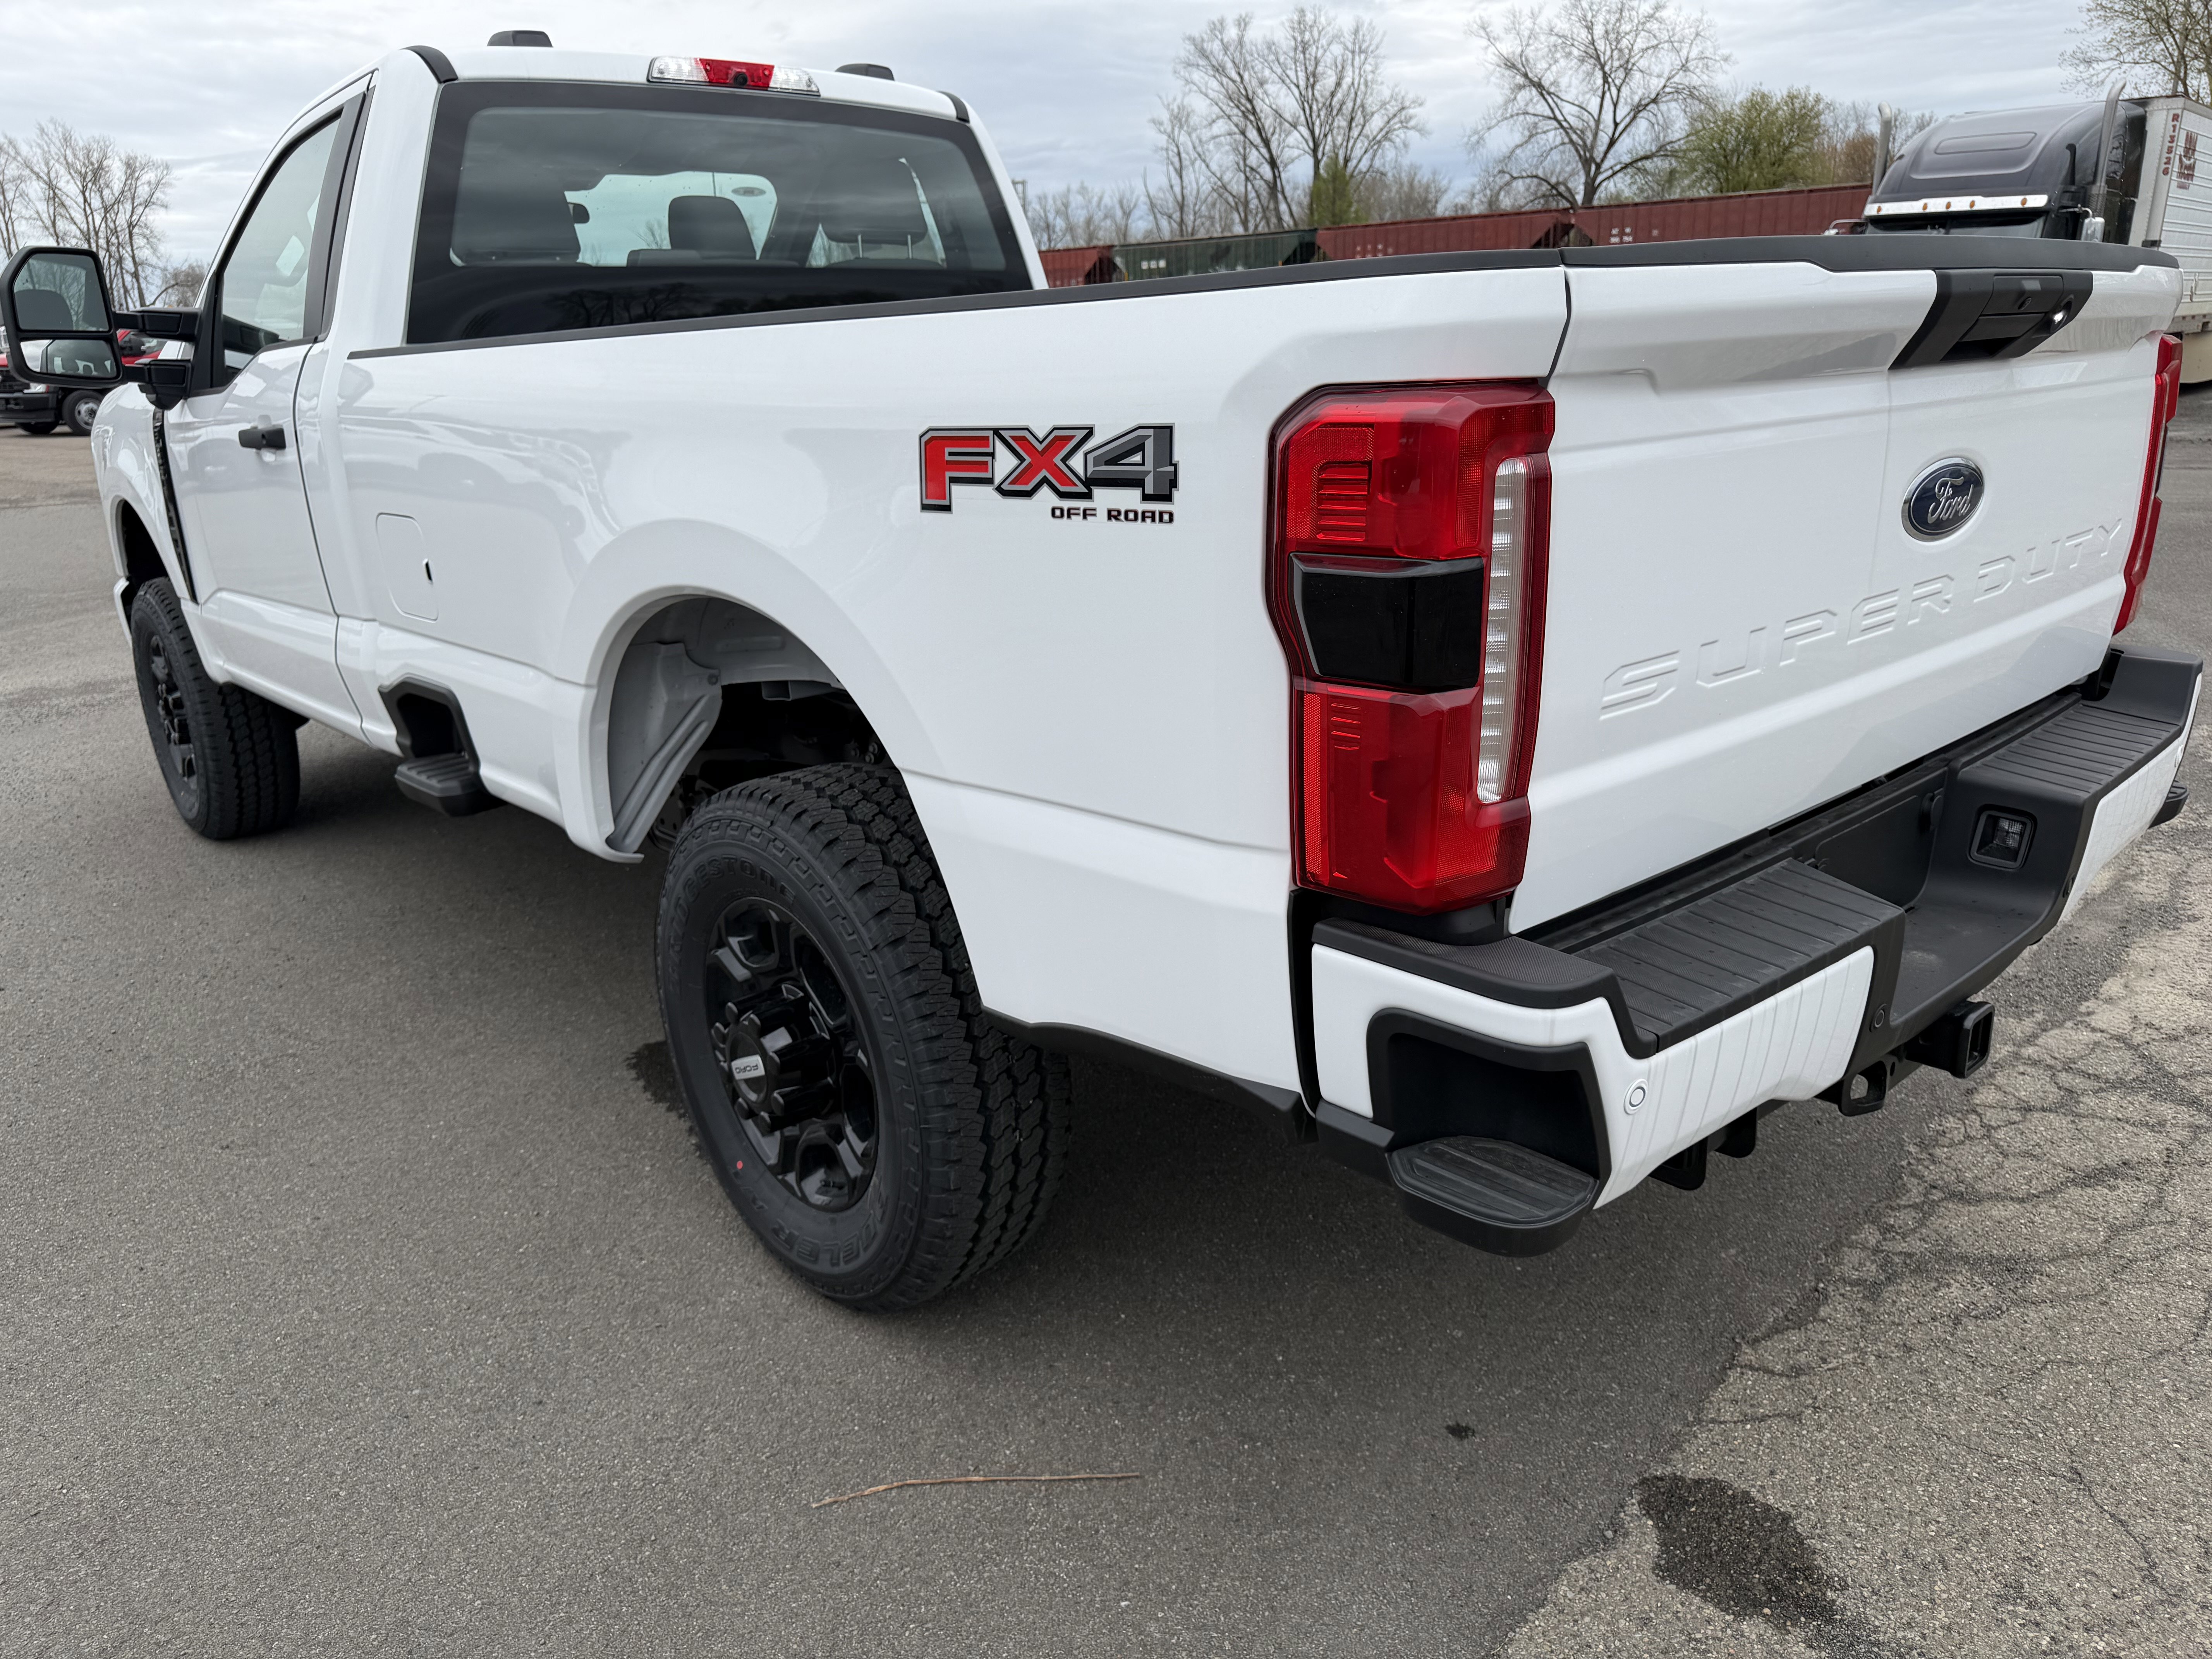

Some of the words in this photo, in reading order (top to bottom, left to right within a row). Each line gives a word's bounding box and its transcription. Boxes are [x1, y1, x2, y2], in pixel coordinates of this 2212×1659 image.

[919, 422, 1179, 514] FX4
[1051, 506, 1097, 520] OFF
[1106, 507, 1175, 524] ROAD
[1928, 476, 1975, 524] Ford
[1599, 574, 1954, 720] SUPER
[1973, 519, 2122, 602] DUTY
[735, 1064, 759, 1073] FORD
